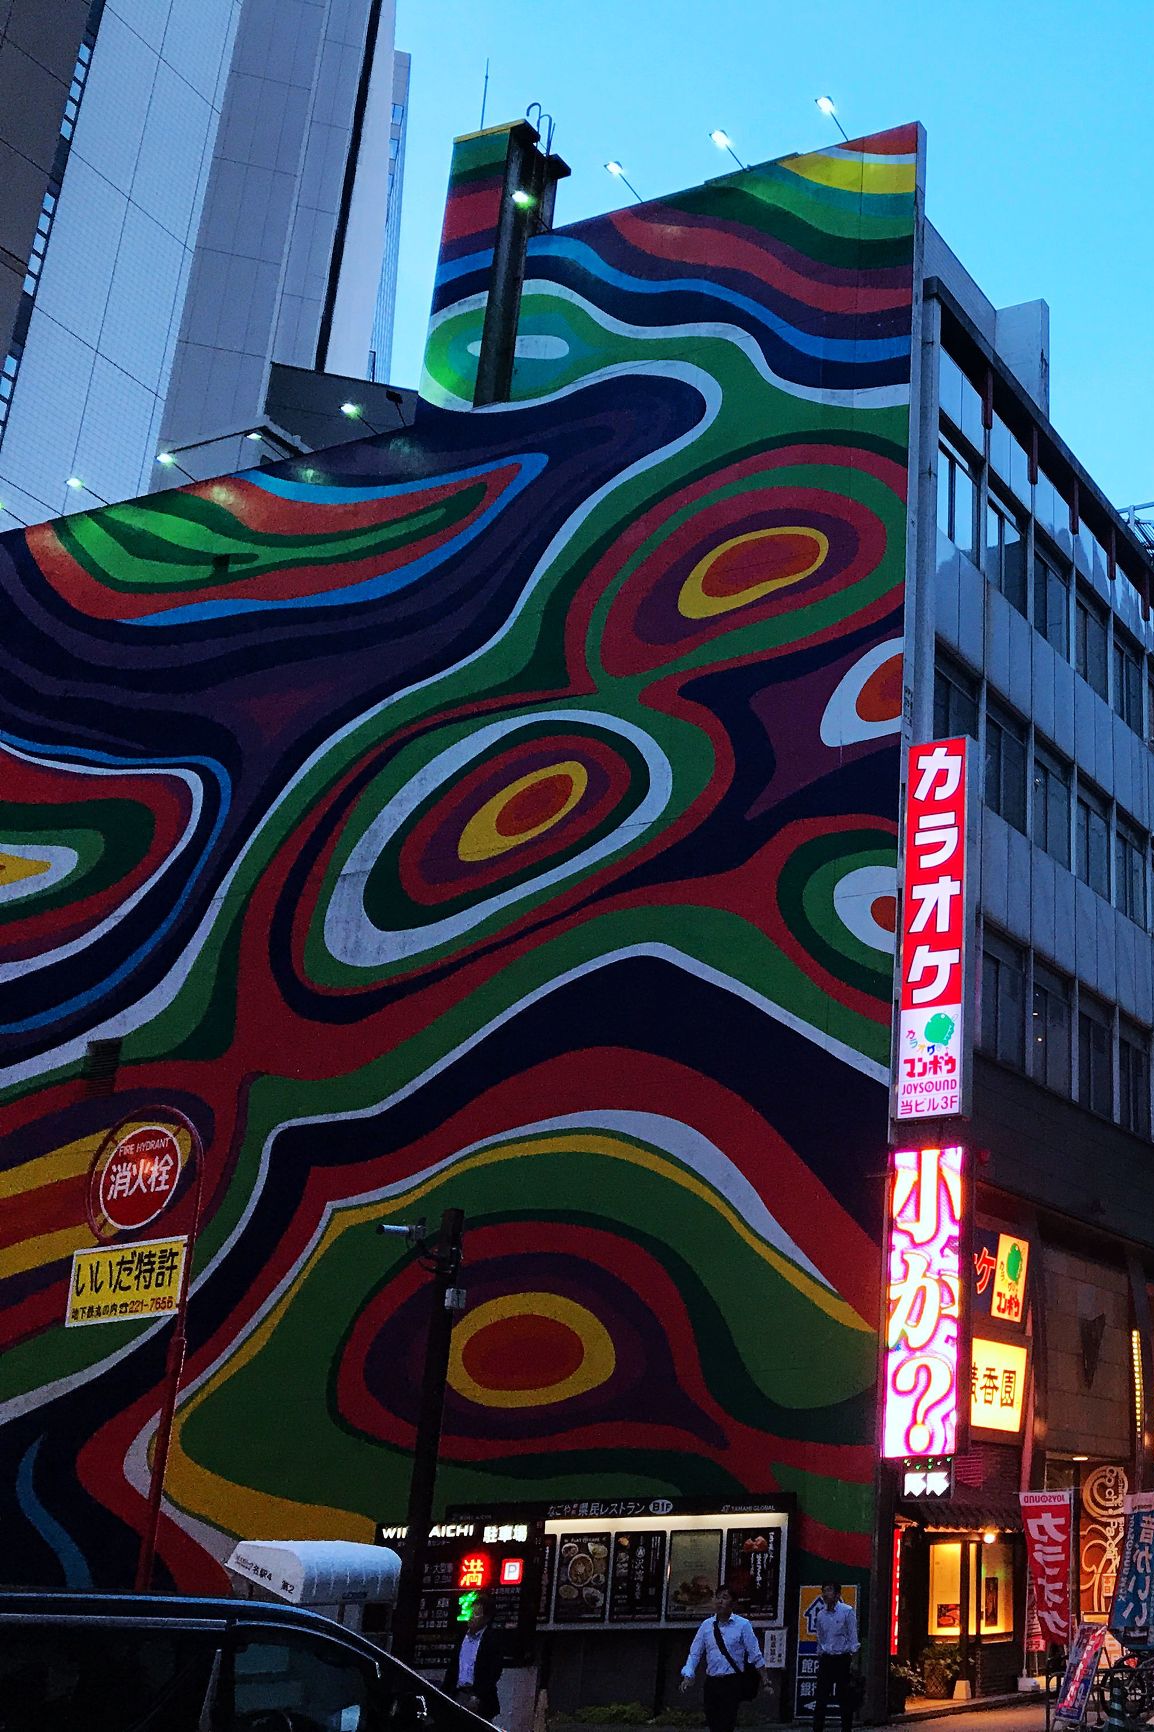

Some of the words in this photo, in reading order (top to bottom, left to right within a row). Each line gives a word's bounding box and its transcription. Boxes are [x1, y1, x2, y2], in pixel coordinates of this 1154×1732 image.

[907, 747, 963, 1005] カラオケ
[903, 1055, 957, 1077] マンボウ
[902, 1079, 957, 1095] JOYSOUND
[900, 1095, 958, 1115] 当ビル3F
[119, 1143, 135, 1157] FIRE
[136, 1137, 171, 1154] HYDRANT
[107, 1155, 175, 1201] 消火栓
[75, 1248, 179, 1298] いいだ特許
[428, 1523, 475, 1539] AICHI
[483, 1524, 528, 1544] 駐車場
[460, 1559, 485, 1588] 満
